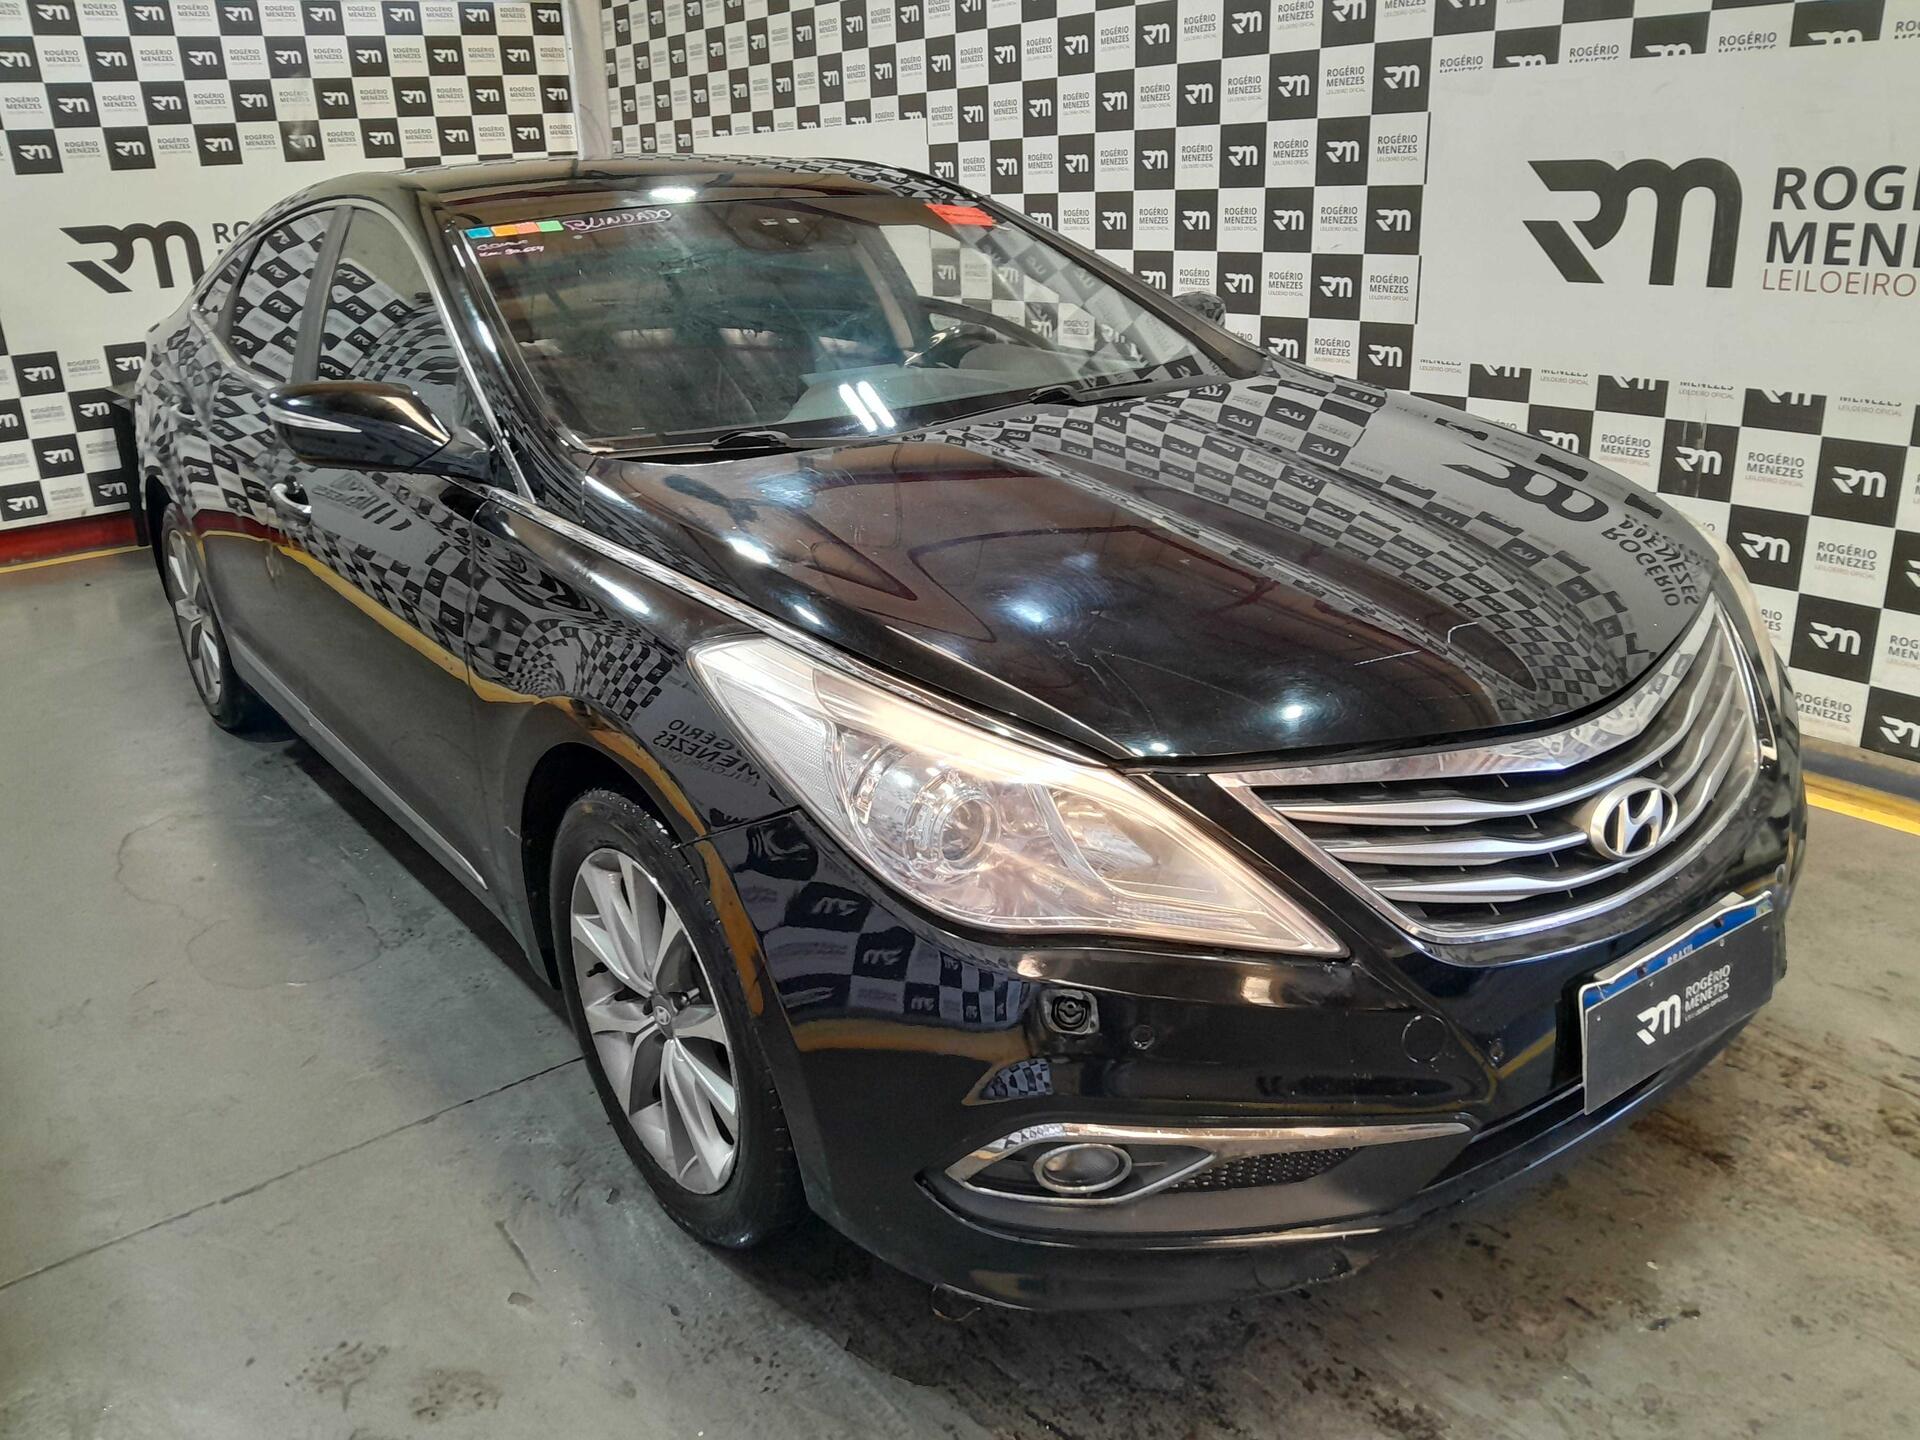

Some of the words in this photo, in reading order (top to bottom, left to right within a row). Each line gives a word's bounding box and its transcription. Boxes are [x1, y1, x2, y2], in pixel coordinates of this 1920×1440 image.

[1278, 0, 1314, 12] ROGÉRIO
[1184, 13, 1216, 24] ROGÉRIO
[1278, 10, 1314, 22] MENEZES
[1184, 23, 1216, 34] MENEZES
[1718, 31, 1777, 47] ROGÉRIO
[1569, 43, 1619, 57] ROGÉRIO
[1440, 56, 1483, 67] ROGÉRIO
[1327, 66, 1364, 78] ROGÉRIO
[1228, 75, 1261, 86] ROGÉRIO
[1326, 76, 1364, 87] MENEZES
[1228, 85, 1261, 95] MENEZES
[1273, 140, 1308, 150] ROGÉRIO
[1378, 135, 1417, 145] ROGÉRIO
[1182, 144, 1212, 154] ROGÉRIO
[1273, 149, 1308, 158] MENEZES
[1377, 144, 1417, 154] MENEZES
[1182, 153, 1213, 162] MENEZES
[1139, 207, 1168, 216] ROGÉRIO
[1224, 206, 1257, 216] ROGÉRIO
[1321, 206, 1357, 215] ROGÉRIO
[563, 209, 672, 231] BLINDADO
[1139, 216, 1168, 224] MENEZES
[1224, 215, 1257, 224] MENEZES
[1321, 215, 1357, 224] MENEZES
[1179, 268, 1209, 278] ROGÉRIO
[1269, 271, 1303, 281] ROGÉRIO
[1179, 277, 1210, 286] MENEZES
[1370, 274, 1408, 284] ROGÉRIO
[1763, 269, 1917, 297] LEILOEIRO
[1269, 280, 1303, 290] MENEZES
[1370, 284, 1408, 294] MENEZES
[1315, 337, 1350, 348] ROGÉRIO
[1314, 346, 1350, 357] MENEZES
[1601, 433, 1651, 448] ROGÉRIO
[1600, 444, 1649, 458] MENEZES
[1748, 452, 1804, 467] ROGÉRIO
[1747, 463, 1803, 479] MENEZES
[1818, 541, 1877, 559] ROGÉRIO
[1816, 552, 1876, 571] MENEZES
[1686, 964, 1730, 997] ROGÉRIO
[1685, 978, 1729, 1013] MENEZES
